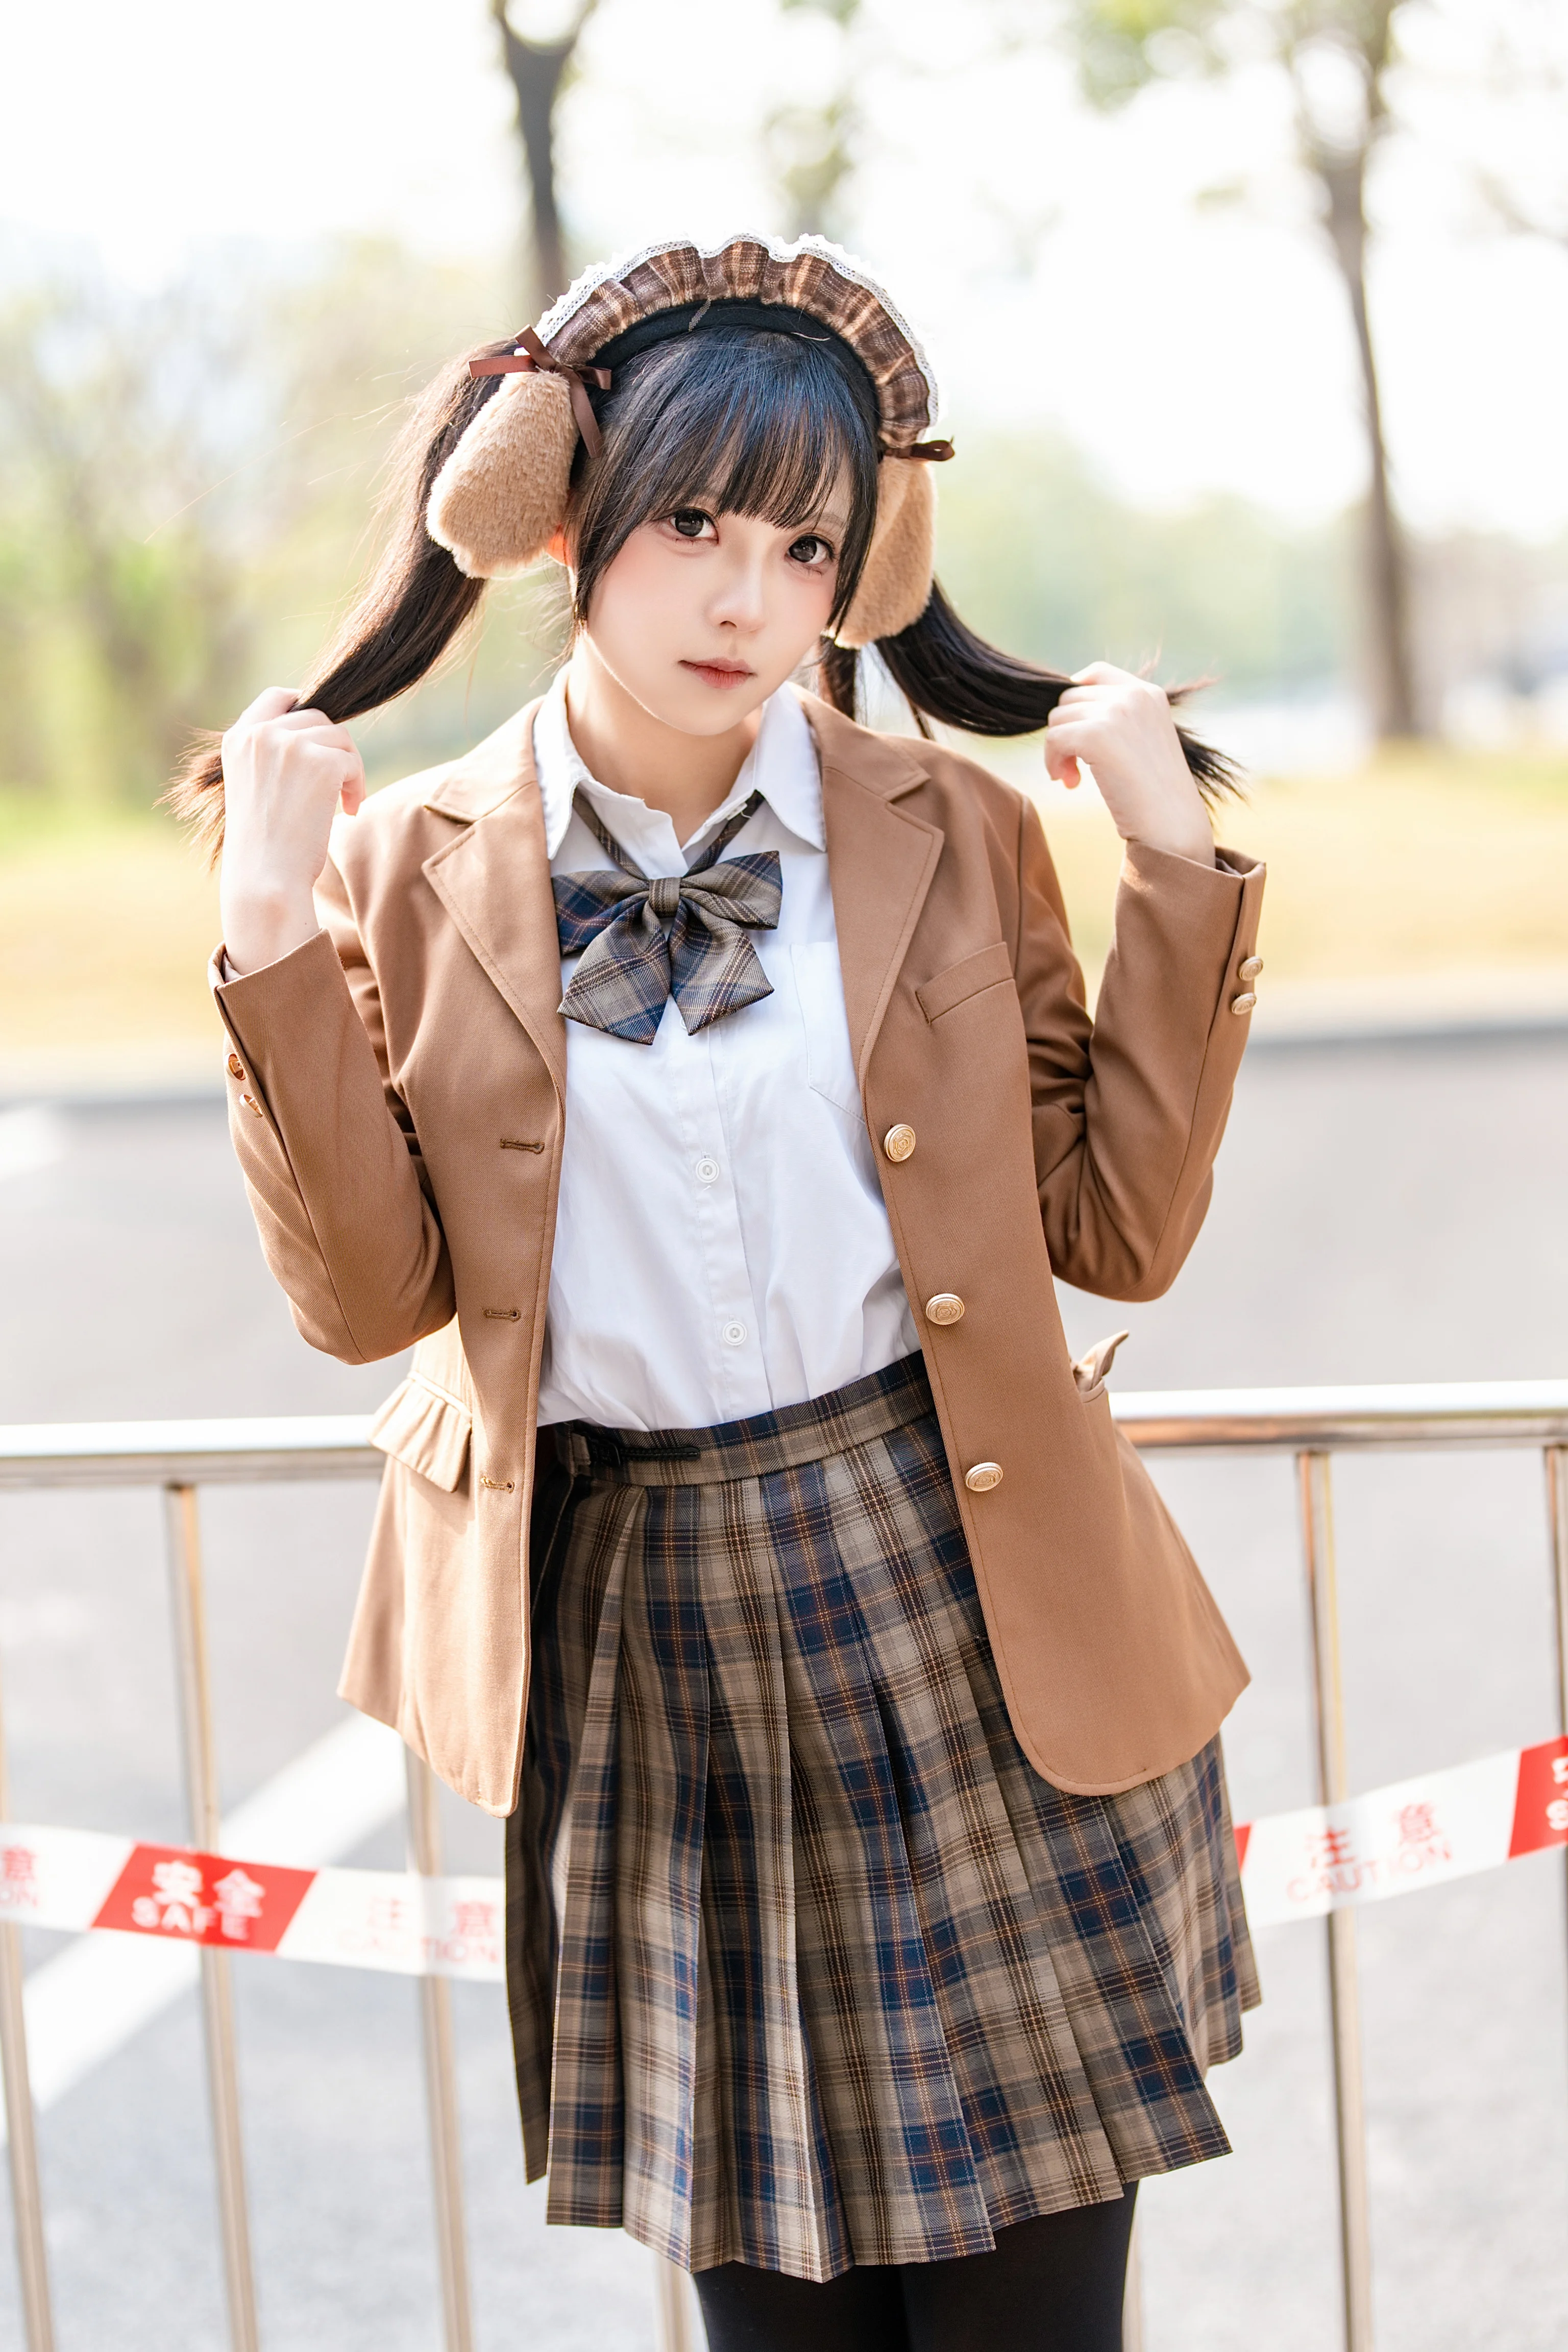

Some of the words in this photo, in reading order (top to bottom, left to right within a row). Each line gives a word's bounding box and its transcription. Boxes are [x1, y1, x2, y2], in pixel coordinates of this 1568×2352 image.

[1304, 1800, 1442, 1869] 注意
[151, 1859, 265, 1918] 安全
[1286, 1841, 1452, 1903] CAUTION
[131, 1895, 250, 1941] SAFE
